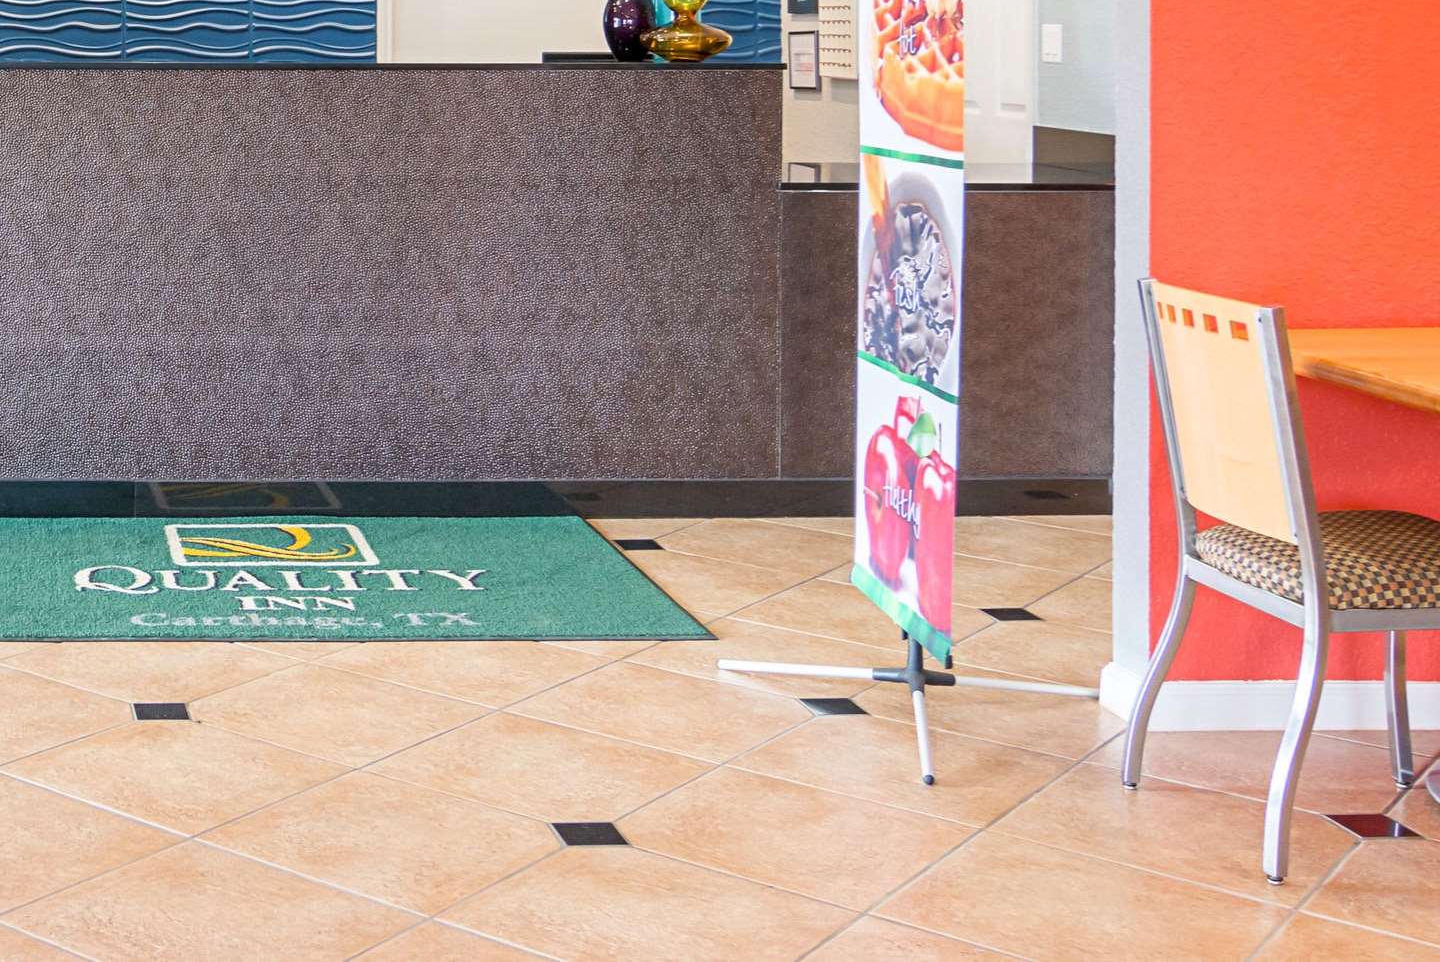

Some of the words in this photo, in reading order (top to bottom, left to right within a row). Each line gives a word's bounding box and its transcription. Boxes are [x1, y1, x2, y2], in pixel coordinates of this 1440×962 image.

[72, 565, 487, 595] QUALITY
[234, 596, 356, 612] INN
[393, 612, 482, 626] TX
